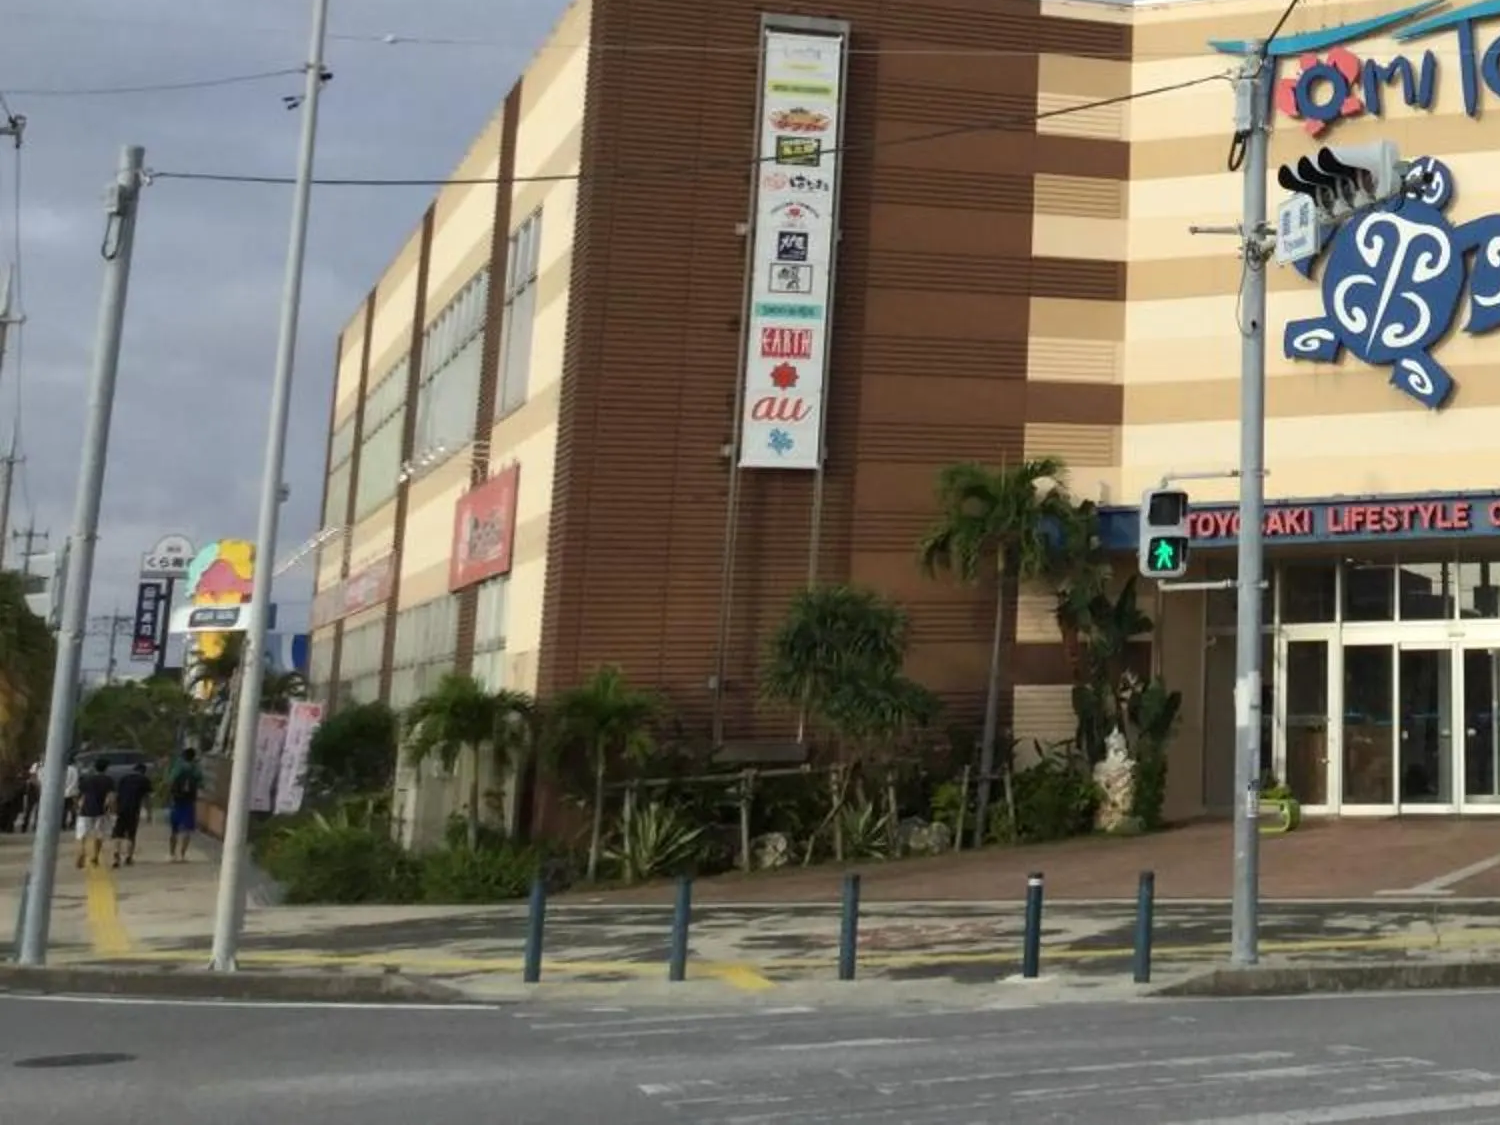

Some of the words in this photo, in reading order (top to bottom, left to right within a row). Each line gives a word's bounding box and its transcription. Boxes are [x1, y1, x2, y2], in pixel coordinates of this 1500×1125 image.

[763, 329, 813, 355] EARTH
[752, 396, 813, 421] au
[1184, 508, 1312, 537] TOYOAKI
[1327, 500, 1471, 533] LIFESTYLE
